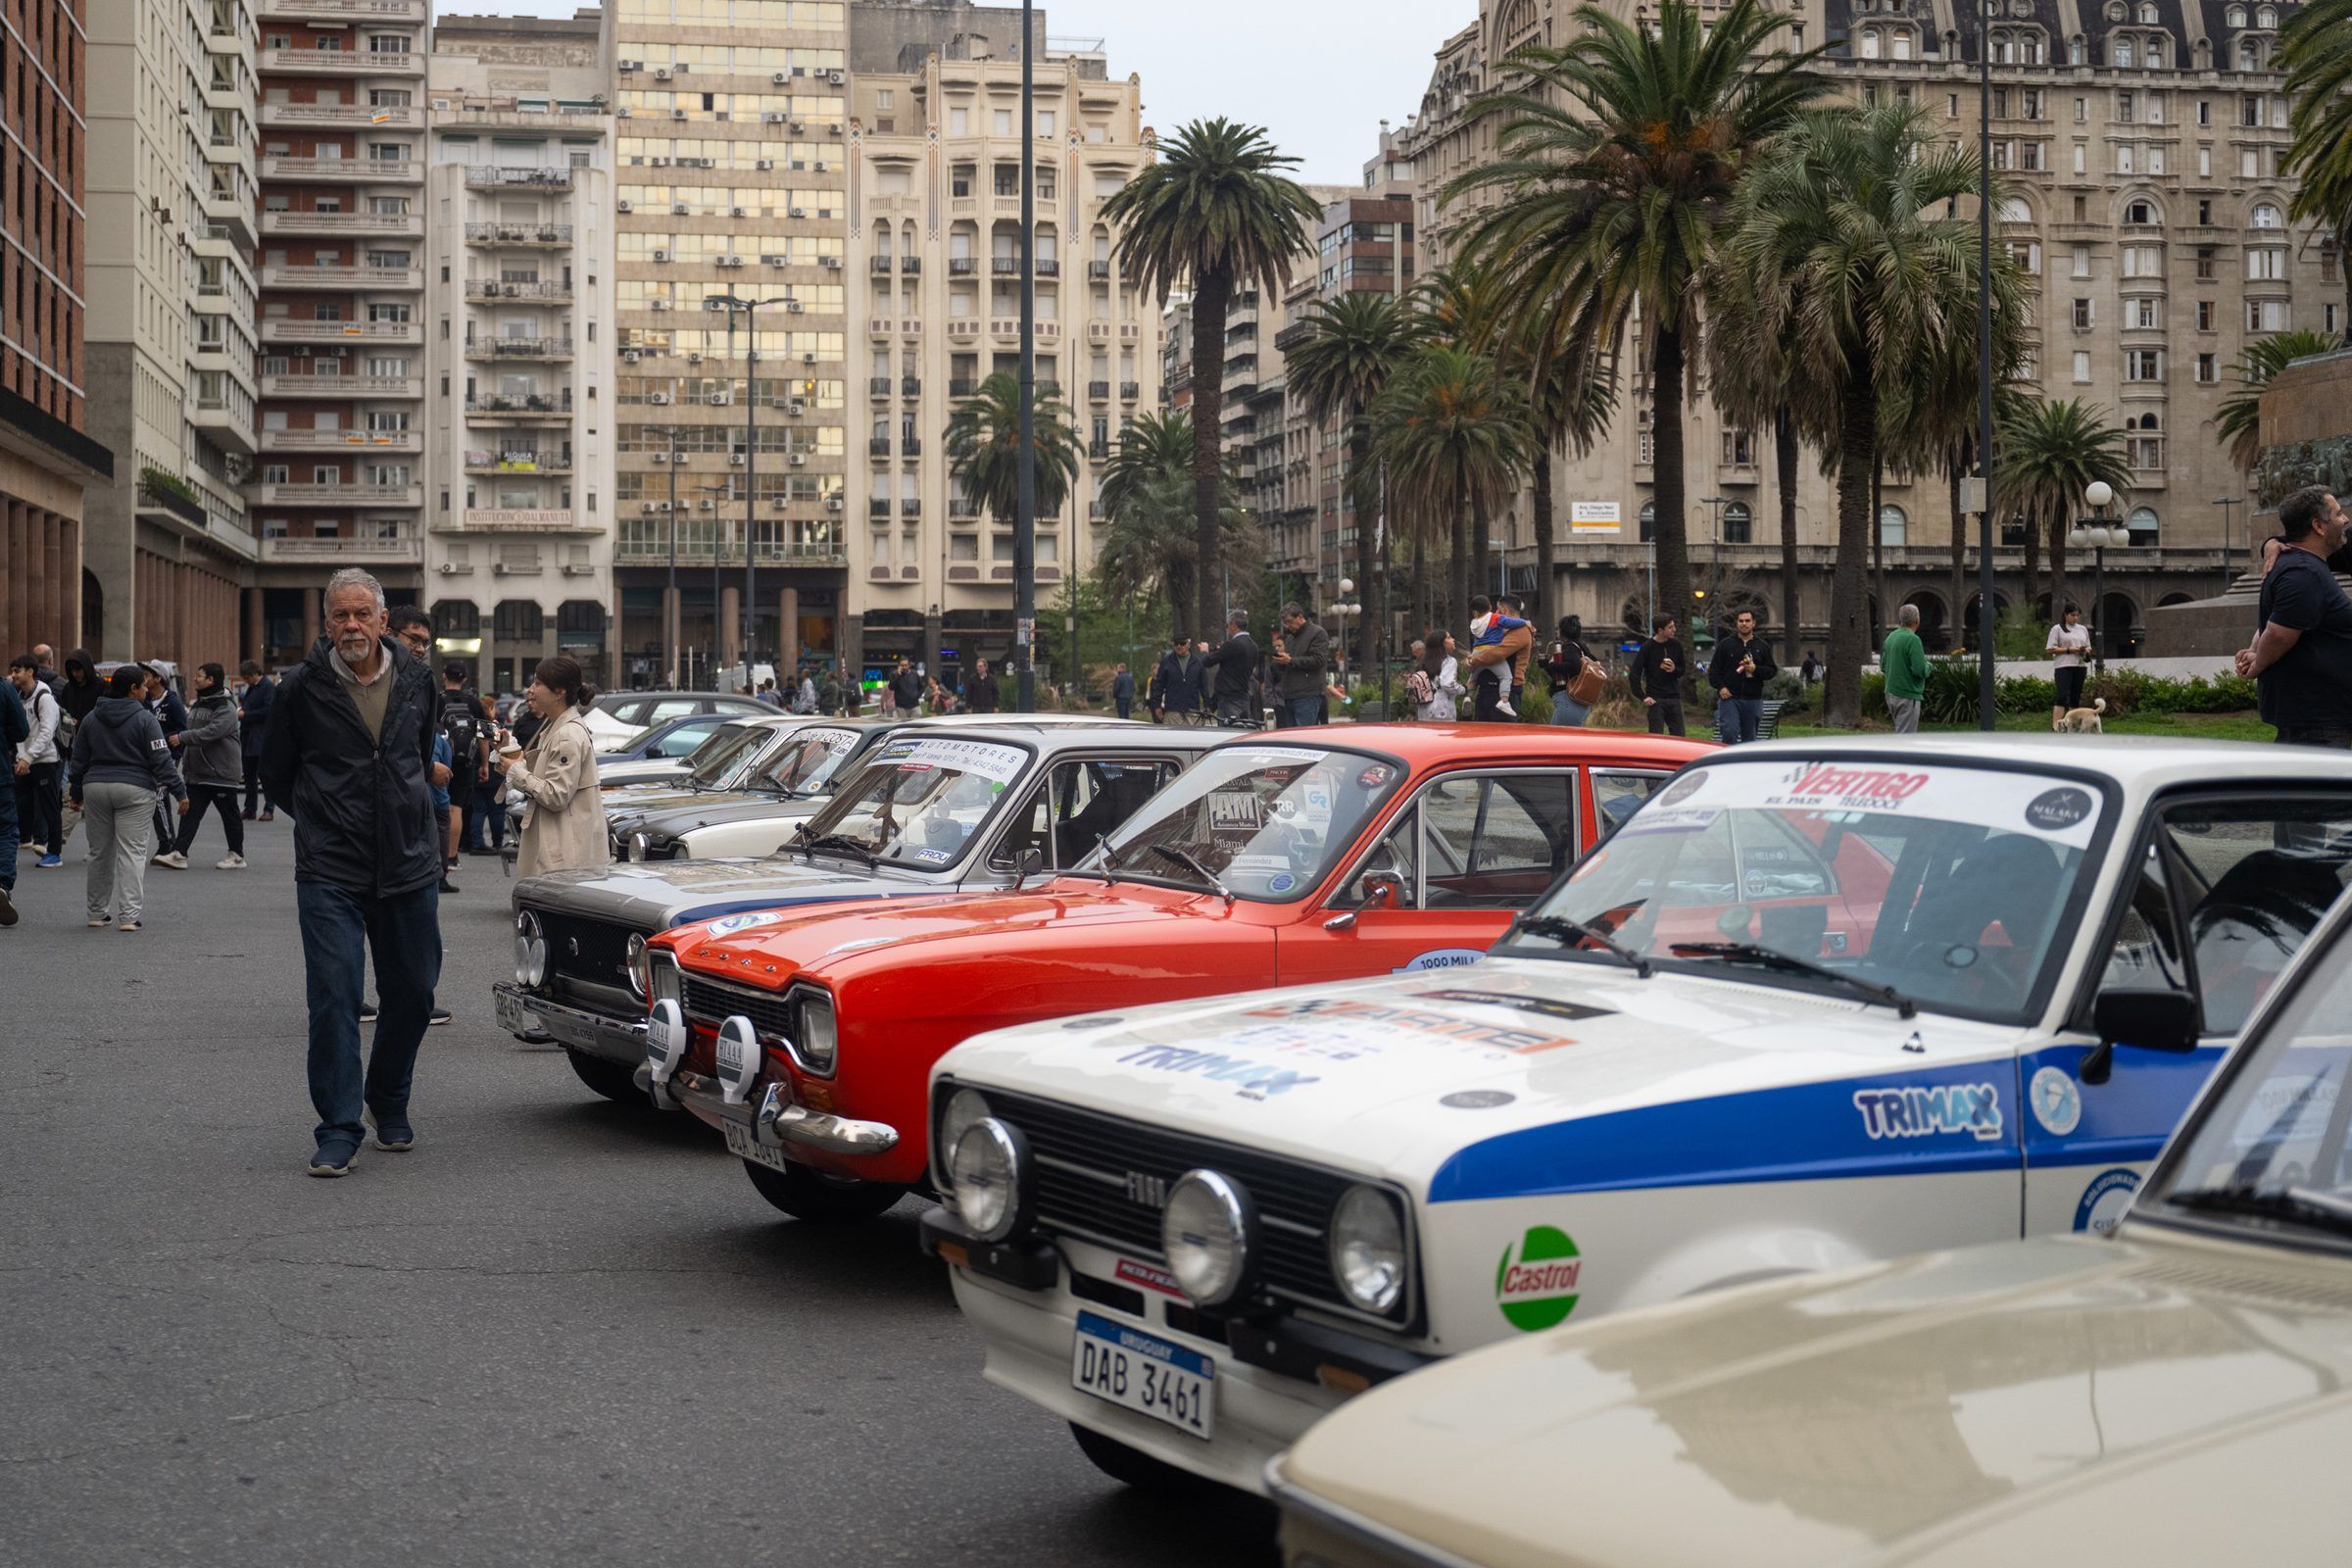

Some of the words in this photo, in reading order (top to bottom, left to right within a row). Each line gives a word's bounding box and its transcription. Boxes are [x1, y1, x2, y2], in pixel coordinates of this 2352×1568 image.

[824, 732, 856, 748] COSTA
[920, 741, 1017, 764] AUTOMOTORES
[1792, 763, 1930, 800] VERTIGO
[1838, 796, 1903, 810] TELEDOCE
[1421, 956, 1448, 970] 1000
[1116, 1044, 1321, 1096] TRIMAX
[1857, 1087, 2001, 1134] TRIMAX
[1503, 1260, 1582, 1294] Castrol
[1119, 1331, 1173, 1360] URUGUAY
[1080, 1340, 1128, 1396] DAB
[1141, 1362, 1202, 1428] 3461
